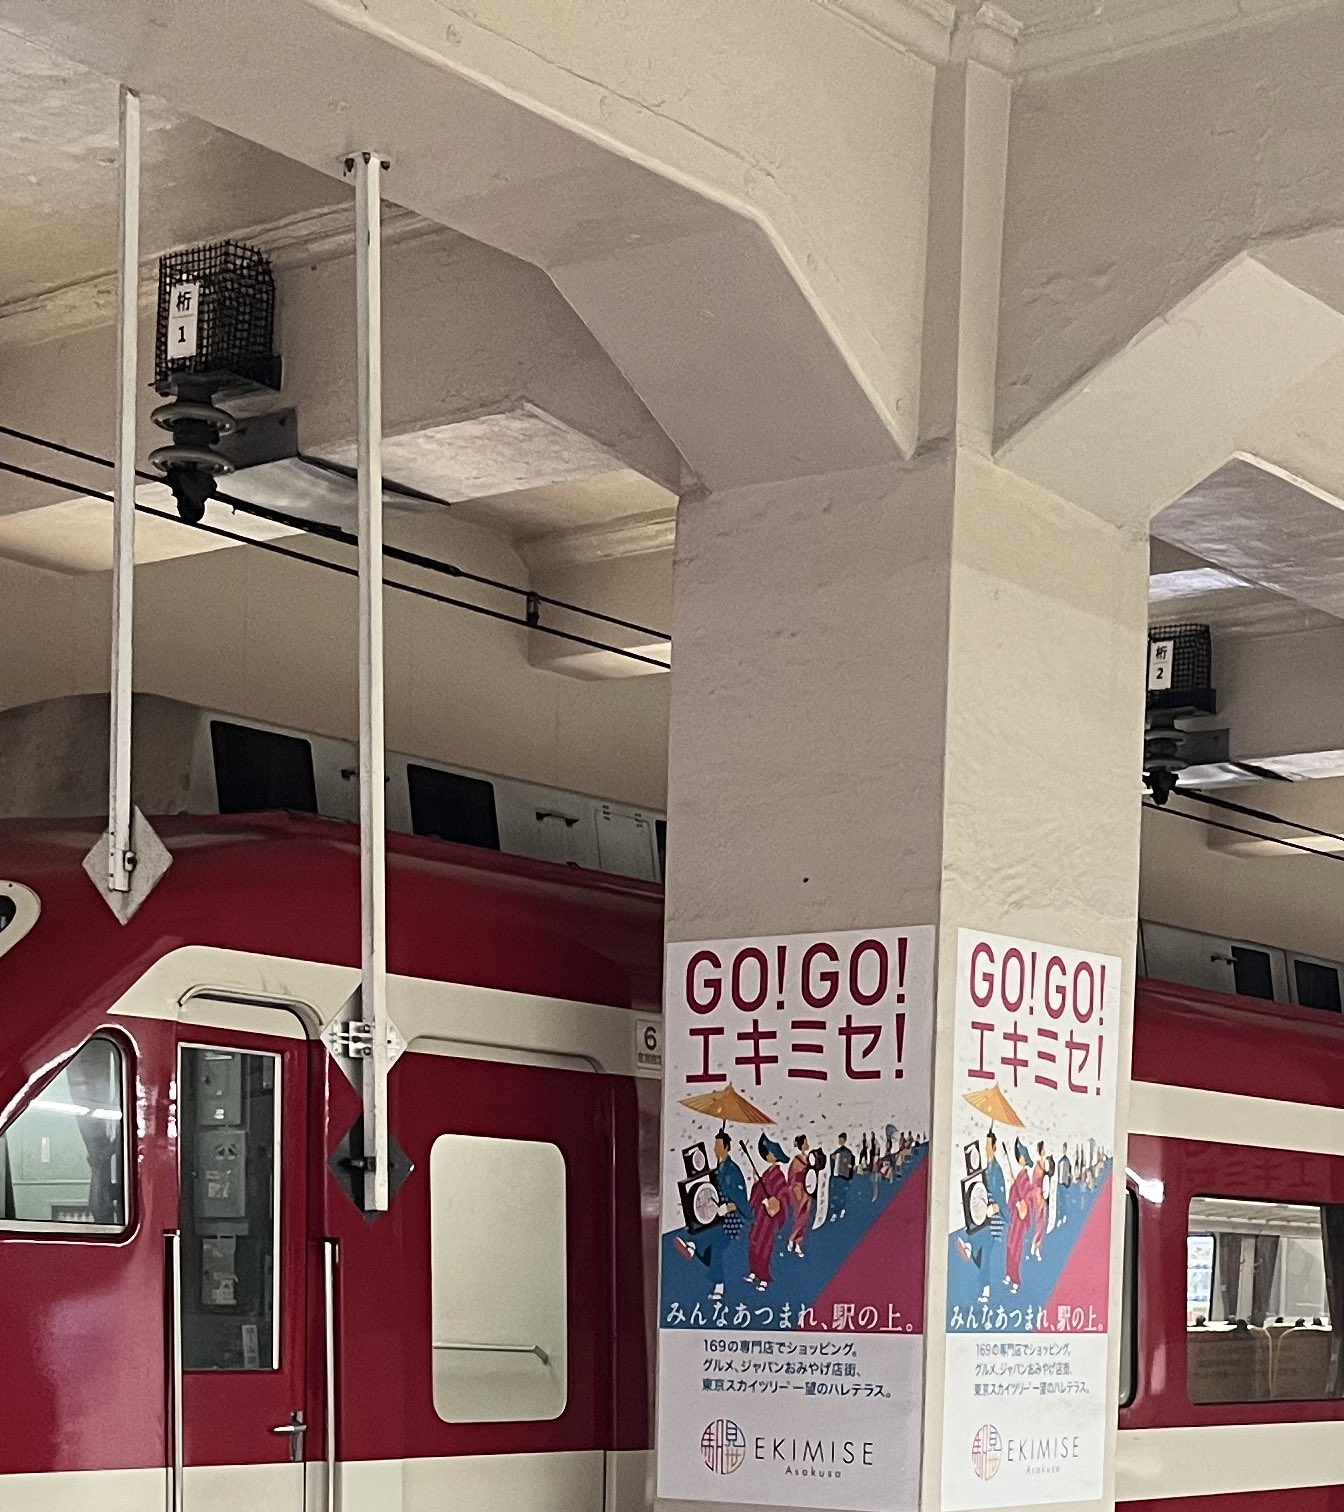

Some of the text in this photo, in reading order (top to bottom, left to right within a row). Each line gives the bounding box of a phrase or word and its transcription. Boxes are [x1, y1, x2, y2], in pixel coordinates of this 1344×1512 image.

[177, 325, 187, 344] 1
[1155, 667, 1164, 680] 2
[644, 1026, 657, 1051] 6
[685, 1012, 906, 1086] エキミセ!
[967, 1020, 1104, 1096] エキミセ!
[666, 1301, 914, 1332] みんなあつまれ、駅の上。
[754, 1437, 874, 1466] EKIMISE
[1007, 1435, 1080, 1462] EKIMISE
[785, 1465, 842, 1478] Asakusa
